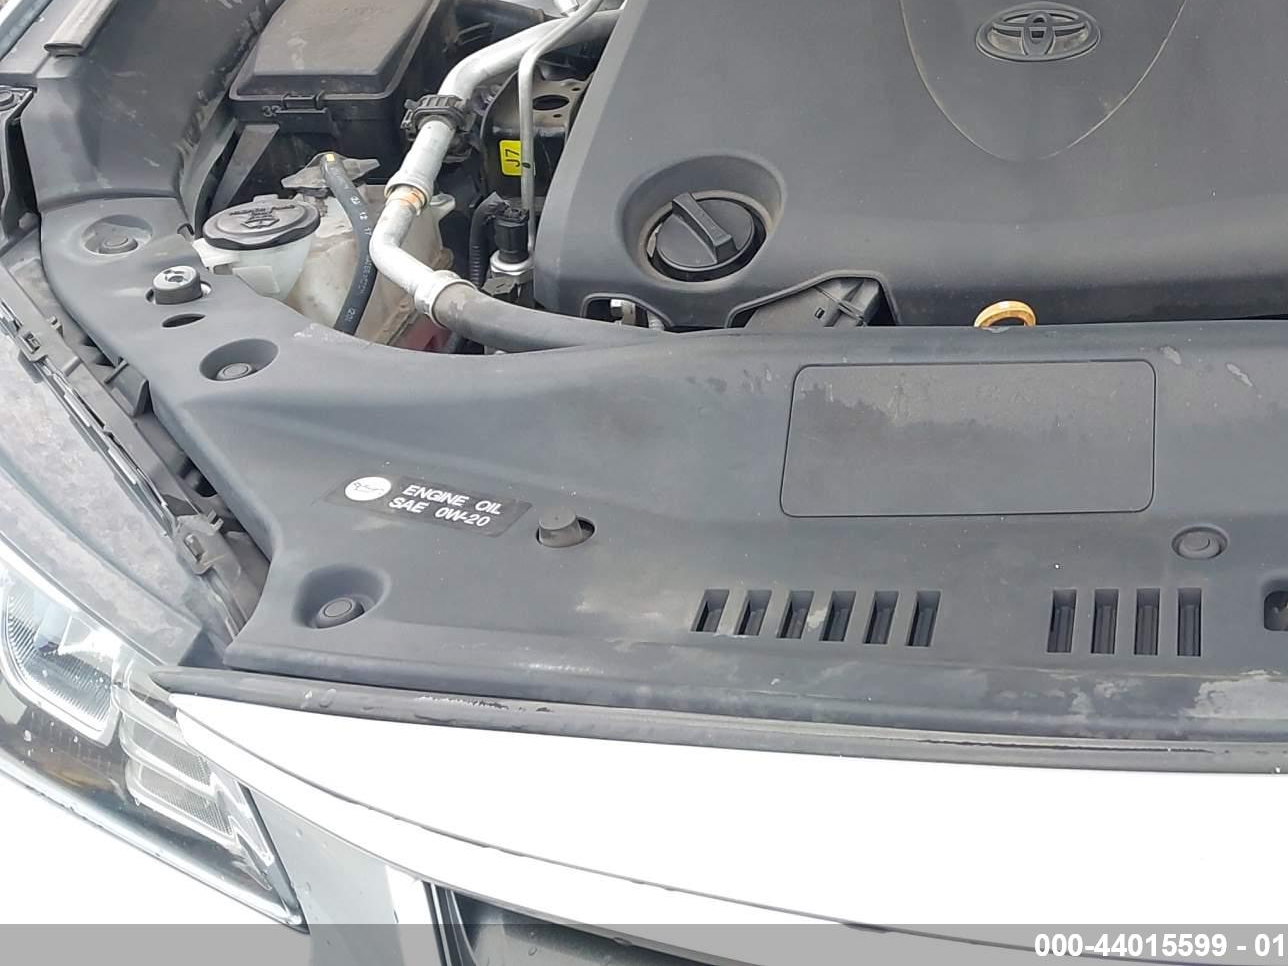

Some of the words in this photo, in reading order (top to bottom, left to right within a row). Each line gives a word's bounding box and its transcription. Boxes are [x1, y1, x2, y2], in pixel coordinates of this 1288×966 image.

[504, 148, 521, 168] J7
[388, 497, 430, 514] SAE
[434, 507, 491, 527] 0W-20
[402, 484, 470, 507] ENGINE
[475, 500, 502, 515] OIL
